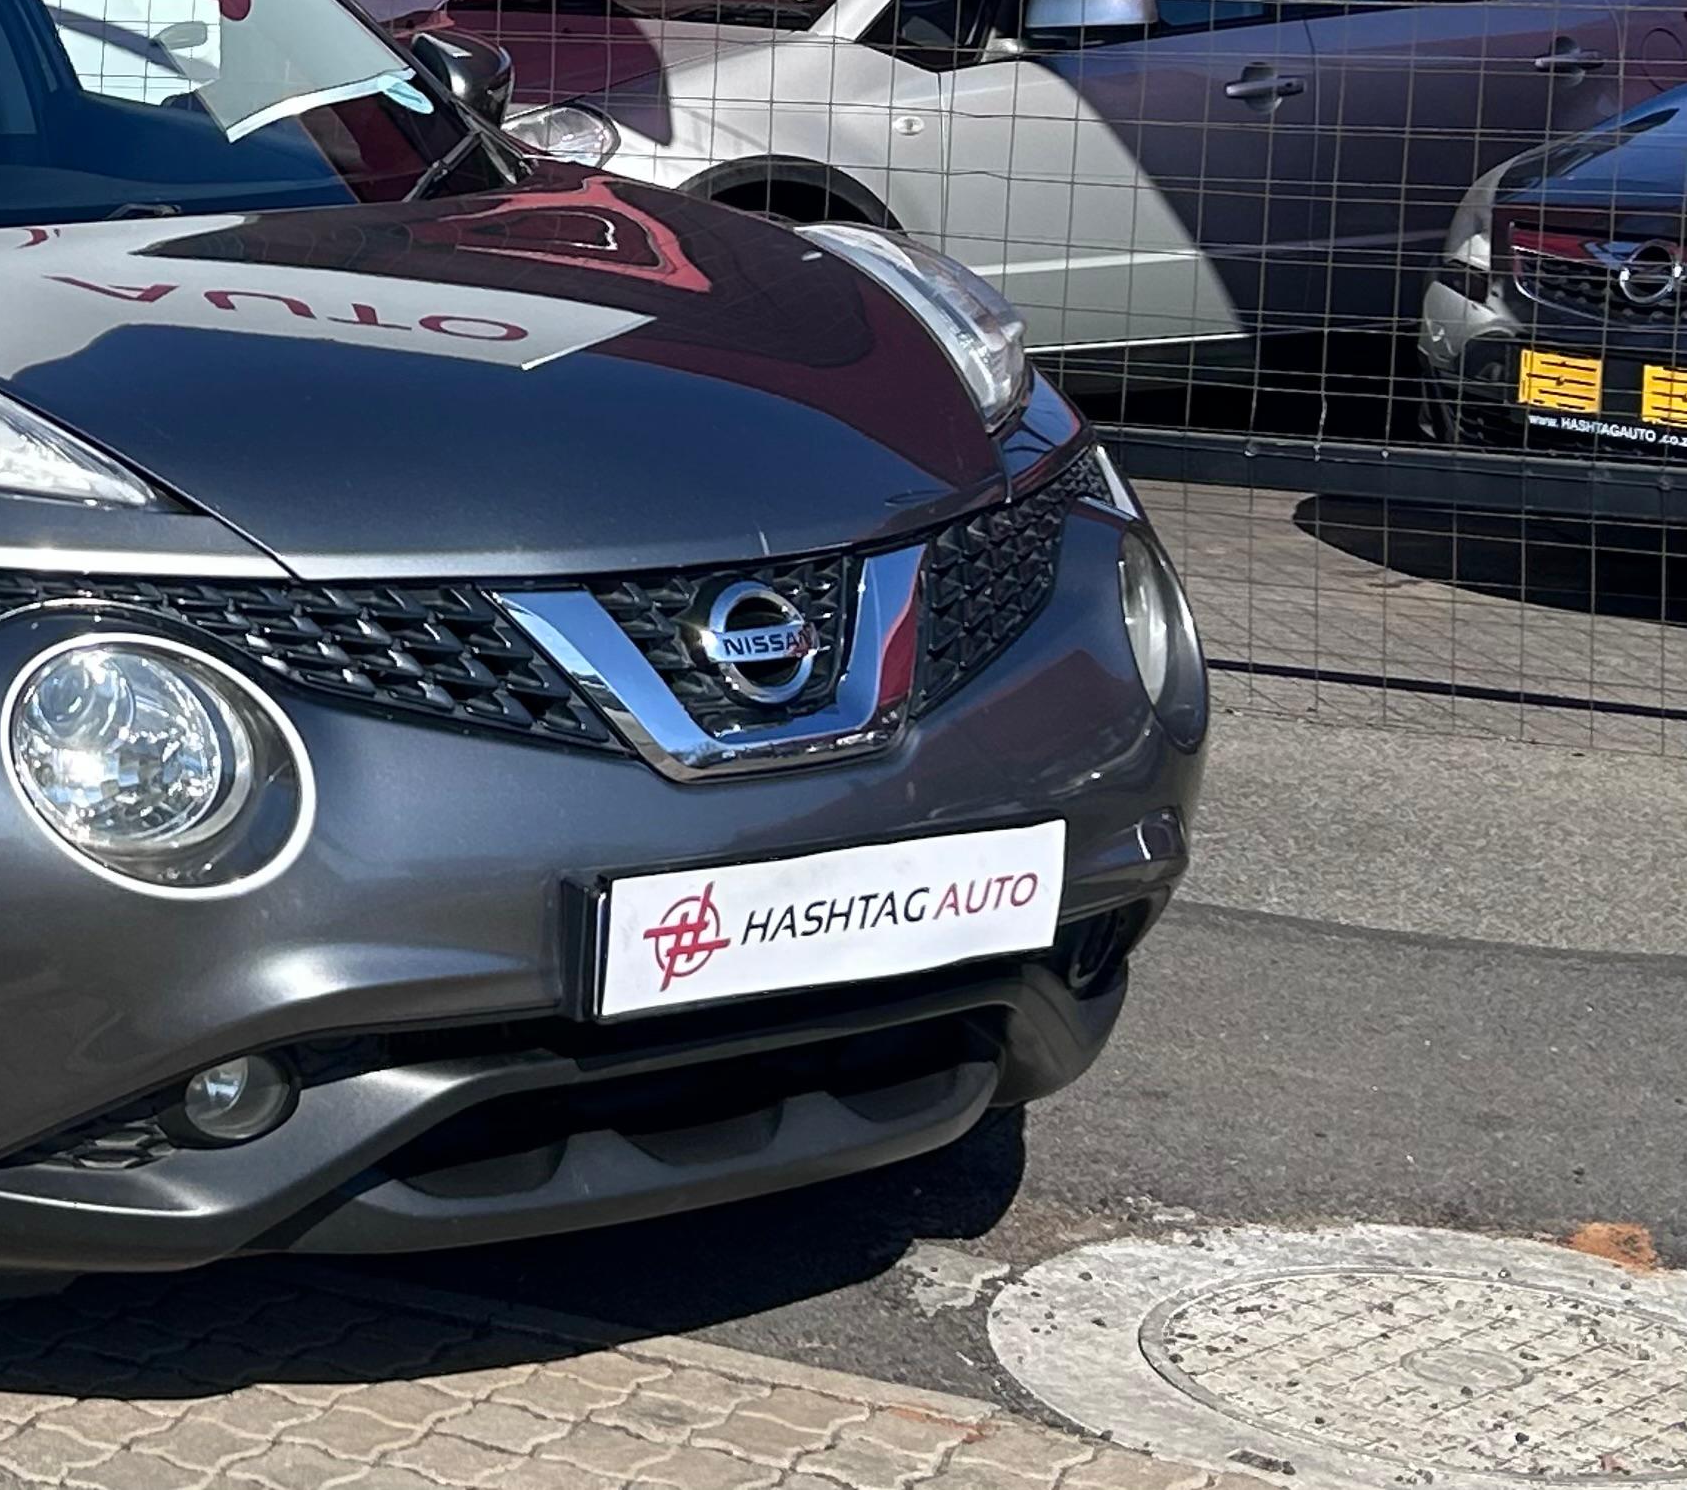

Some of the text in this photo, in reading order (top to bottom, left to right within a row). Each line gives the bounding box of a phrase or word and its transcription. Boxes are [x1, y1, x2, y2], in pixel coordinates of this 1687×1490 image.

[1561, 417, 1656, 443] HASHTAGAUTO
[740, 872, 1038, 945] HASHTAG AUTO
